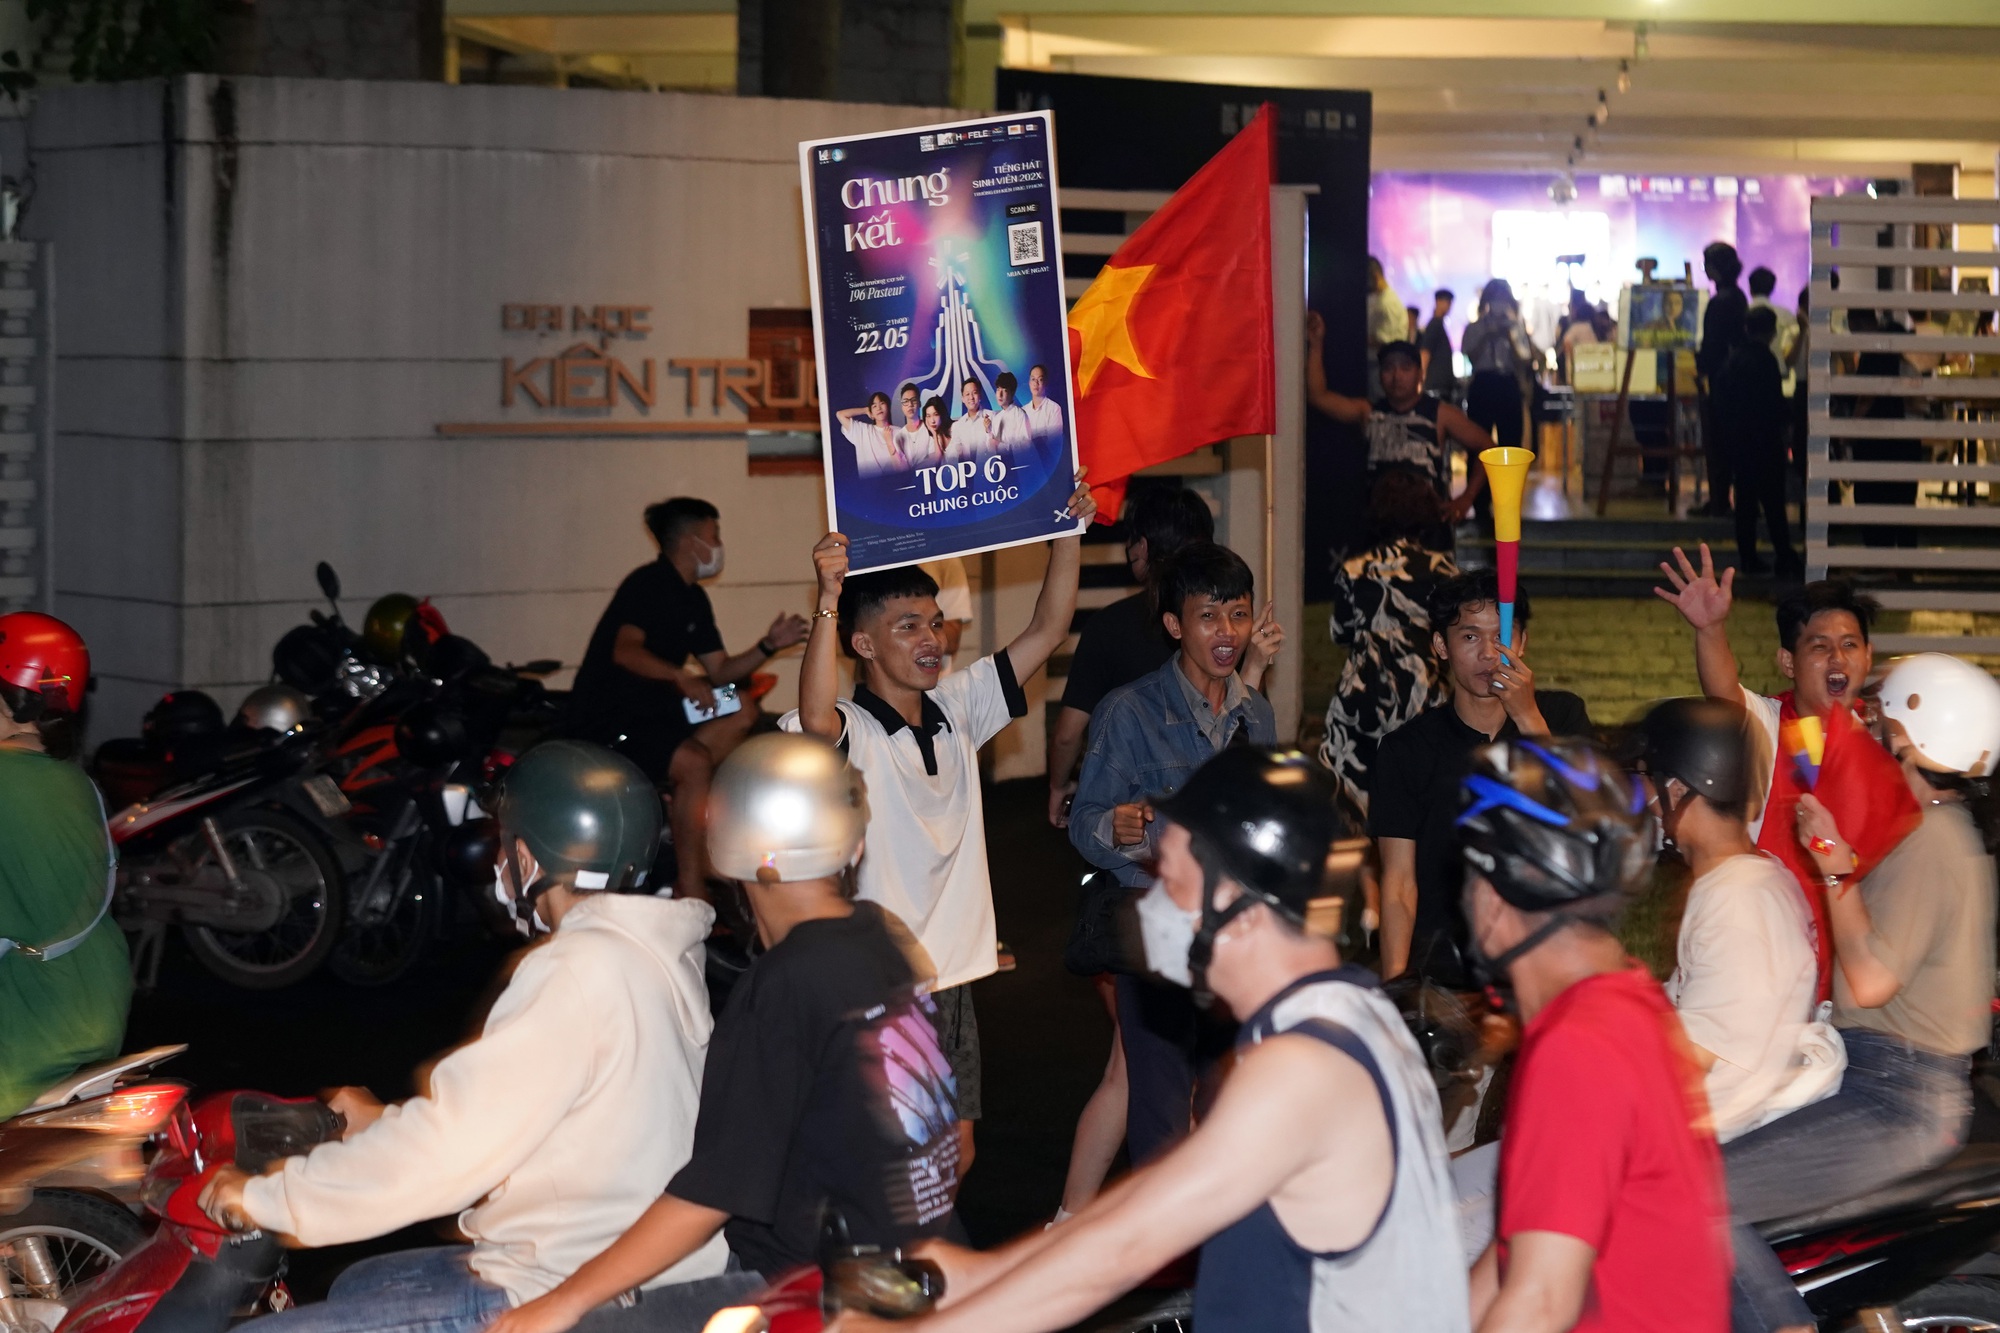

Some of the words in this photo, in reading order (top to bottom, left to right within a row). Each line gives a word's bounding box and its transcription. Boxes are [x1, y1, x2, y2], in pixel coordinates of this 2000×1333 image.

[994, 162, 1021, 173] TIẾNG
[1022, 159, 1041, 171] HÁT
[841, 168, 950, 209] Chung
[972, 178, 995, 189] SINH
[996, 174, 1018, 185] VIÊN
[1019, 172, 1042, 182] 202X
[1009, 206, 1026, 214] SCAN
[1027, 204, 1036, 212] ME
[844, 209, 902, 252] Kết
[849, 288, 866, 303] 196
[867, 285, 905, 300] Pasteur
[854, 322, 875, 331] 17h00
[886, 317, 908, 326] 21h00
[854, 326, 909, 354] 22.05
[669, 336, 818, 408] TRÚ
[915, 460, 977, 496] TOP
[983, 454, 1007, 483] 6
[908, 495, 968, 518] CHUNG
[971, 485, 1019, 508] CUỘC
